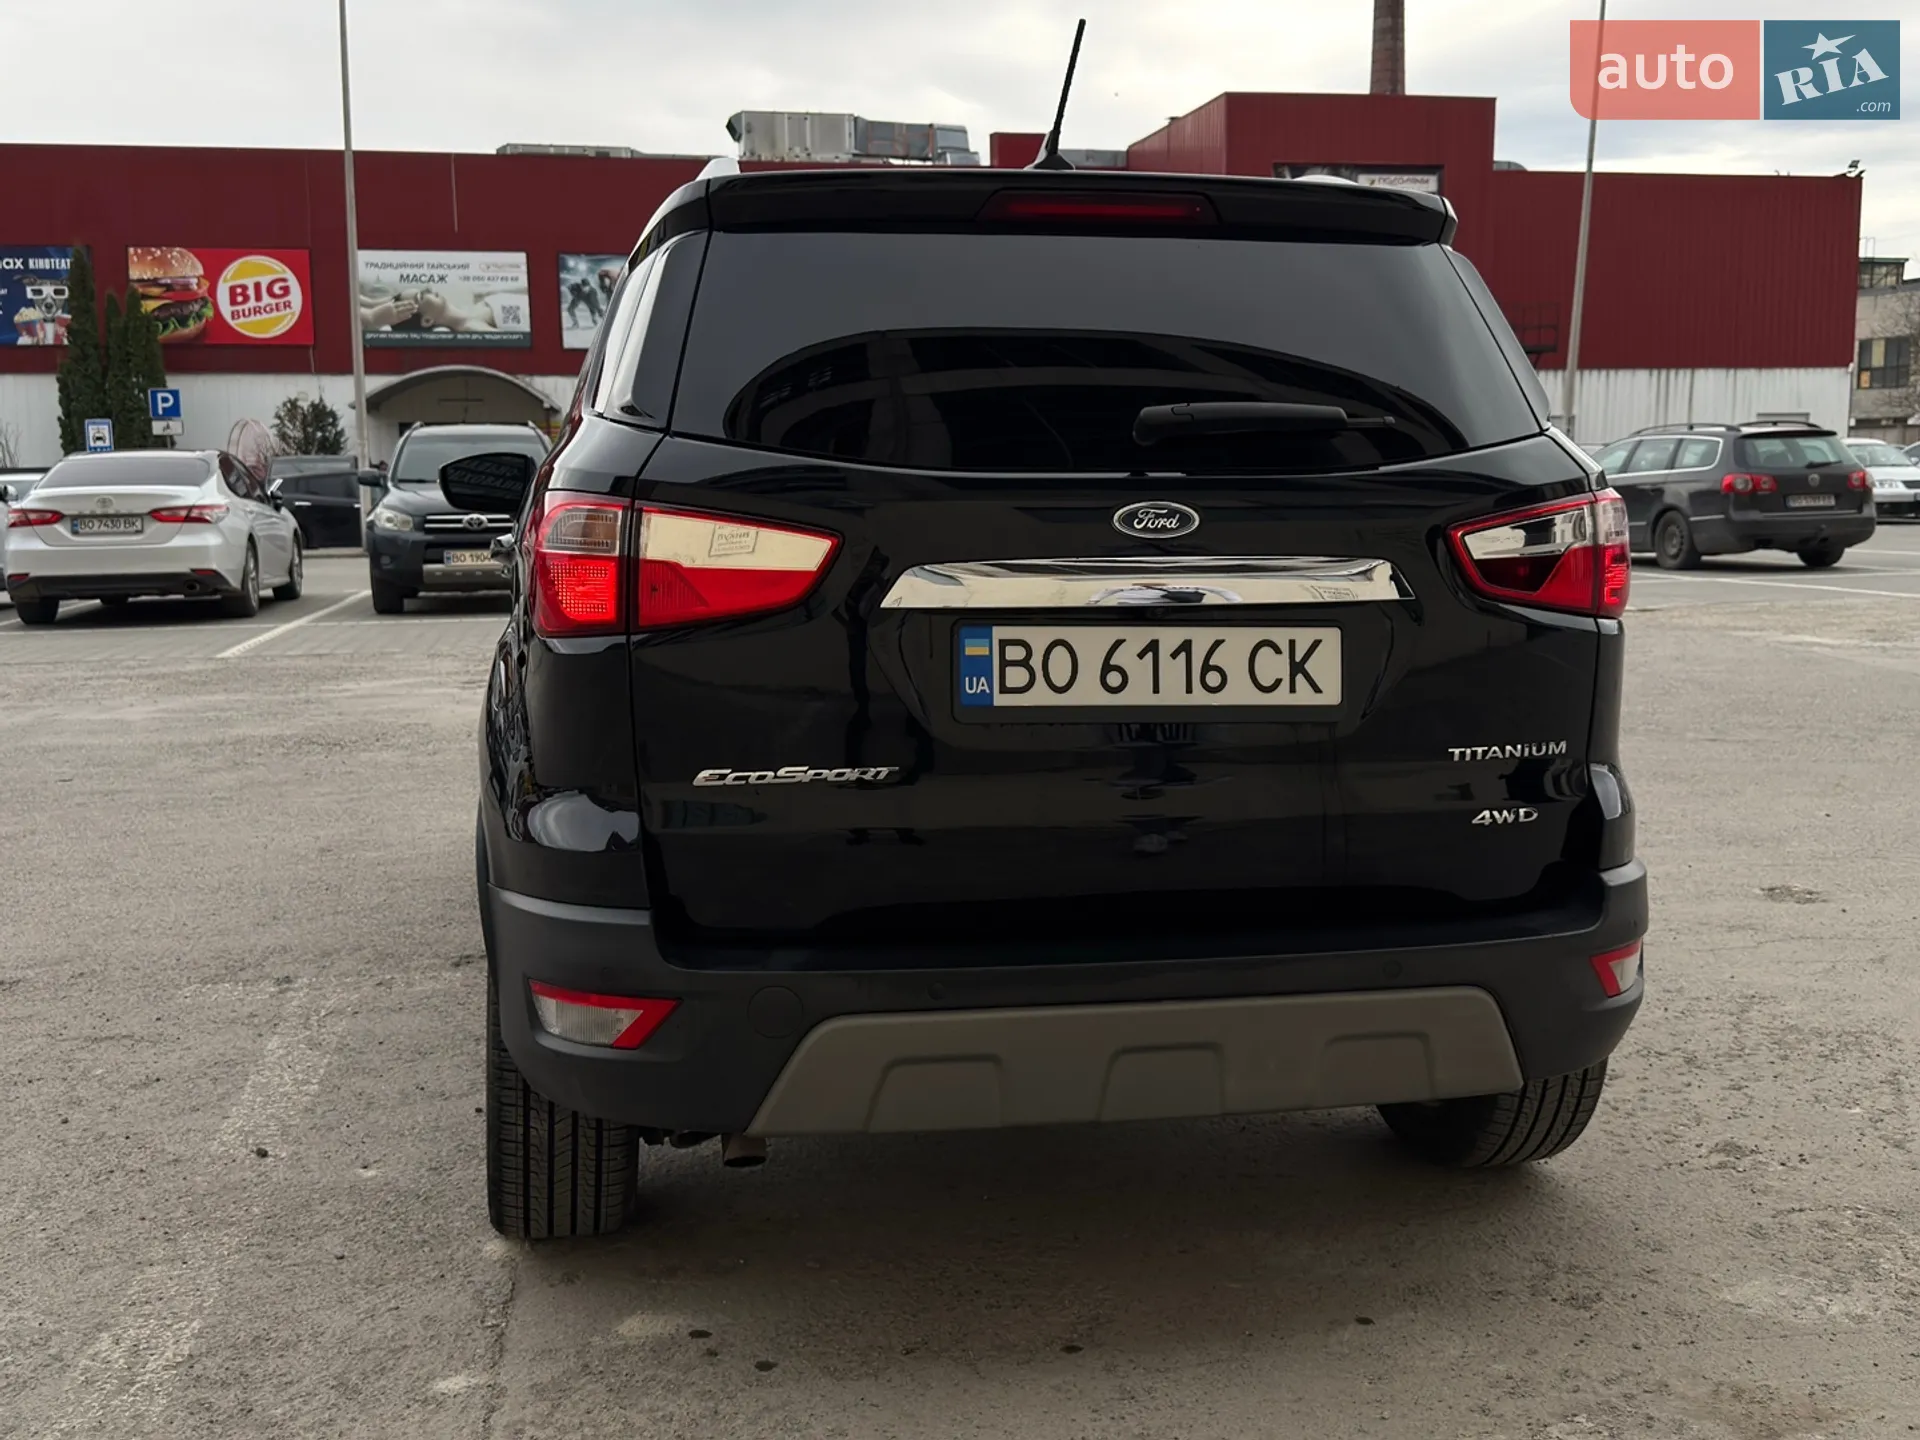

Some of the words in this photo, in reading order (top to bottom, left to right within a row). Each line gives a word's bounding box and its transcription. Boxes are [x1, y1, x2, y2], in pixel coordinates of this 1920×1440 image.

[0, 257, 24, 270] ax
[28, 257, 72, 270] КІНОТЕАТ
[399, 273, 449, 284] МАСАЖ
[228, 277, 291, 307] BIG
[231, 300, 292, 321] BURGER
[157, 392, 174, 415] P
[1133, 508, 1180, 529] Ford
[998, 638, 1080, 695] BO
[1099, 638, 1229, 695] 6116
[1247, 638, 1324, 695] CK
[965, 676, 990, 695] UA
[1471, 807, 1539, 826] 4WD
